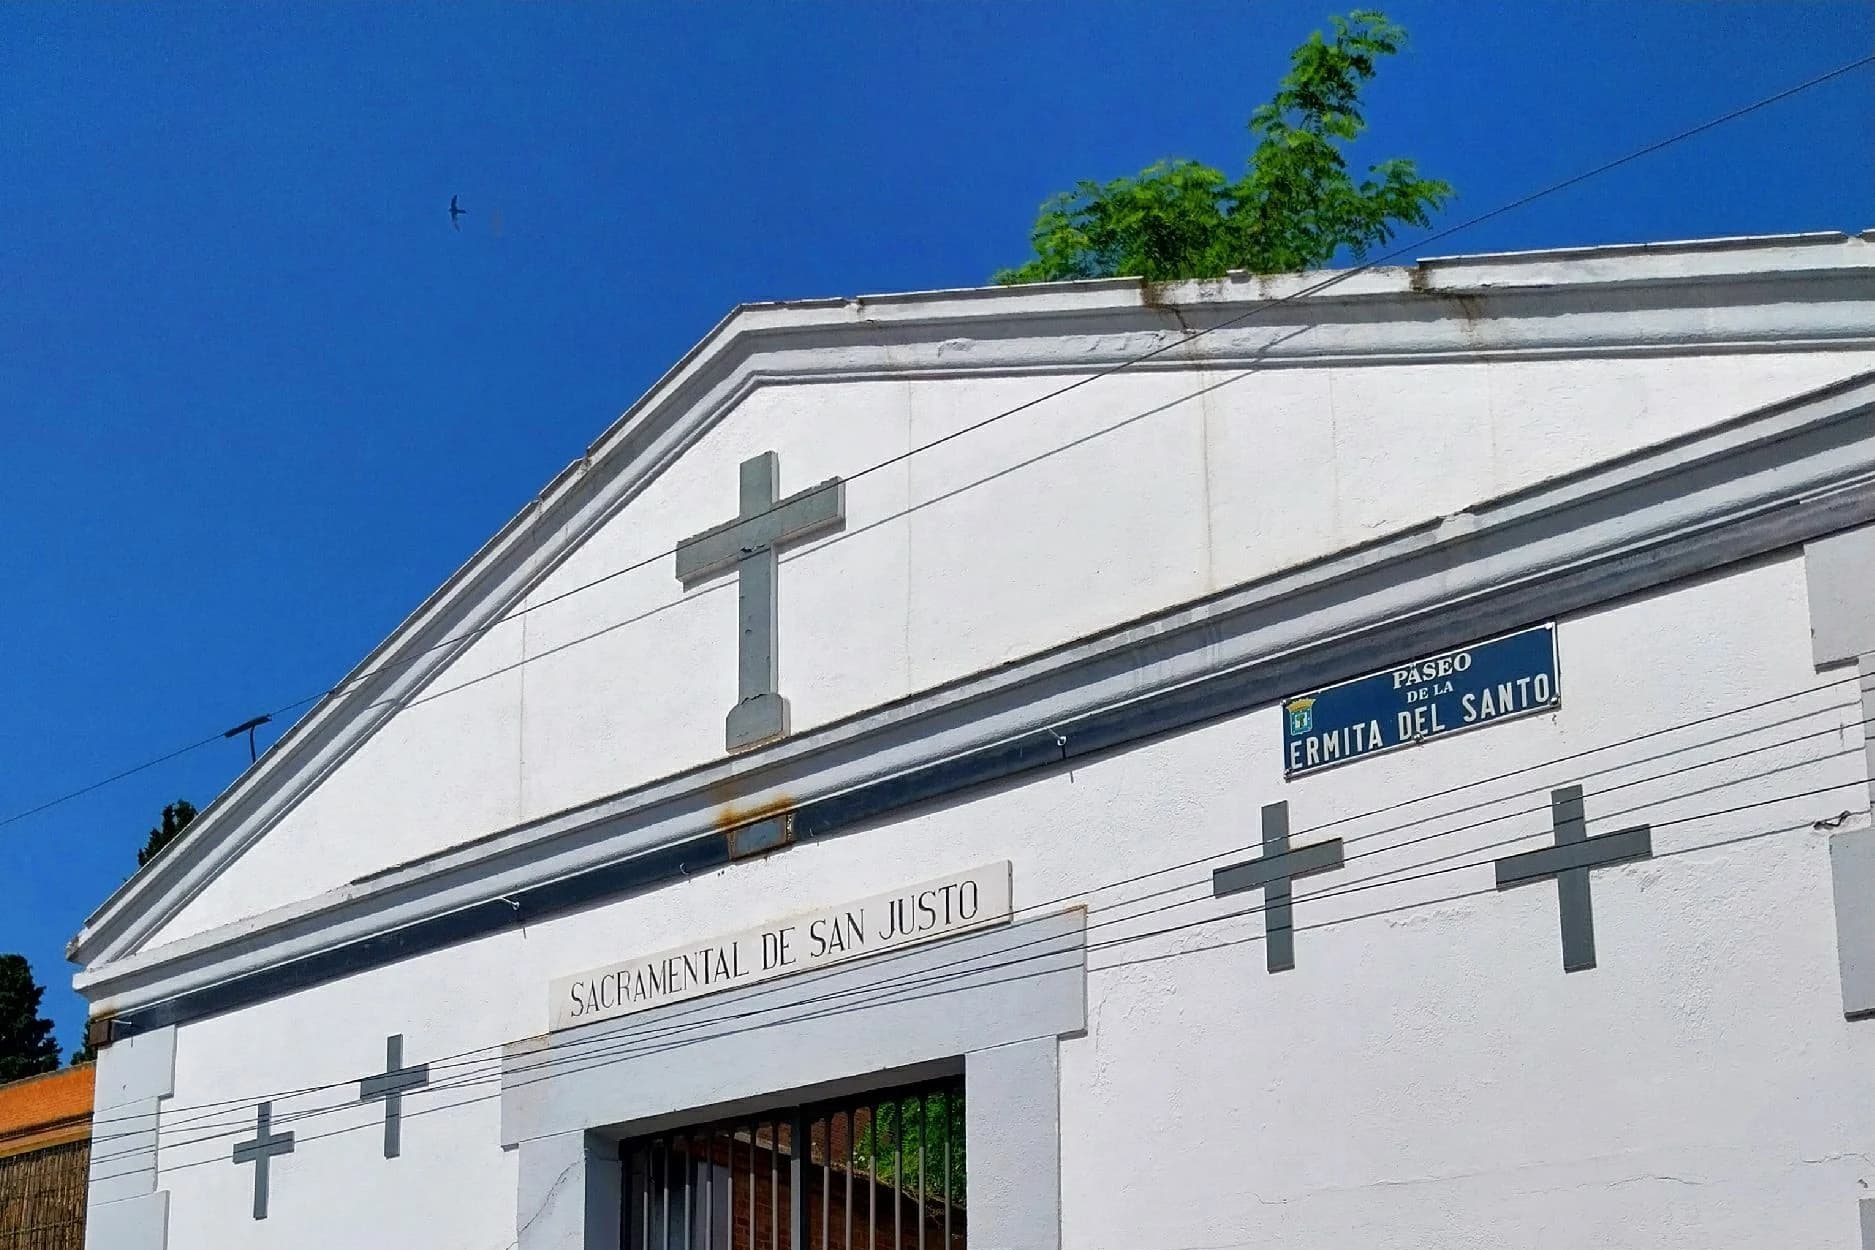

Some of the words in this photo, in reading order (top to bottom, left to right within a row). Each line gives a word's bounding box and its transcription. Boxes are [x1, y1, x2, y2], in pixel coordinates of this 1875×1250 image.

[1393, 652, 1472, 689] PASEO
[1407, 687, 1429, 704] DE
[1433, 680, 1454, 697] LA
[1290, 719, 1384, 769] ERMITA
[1398, 704, 1445, 740] DEL
[1461, 673, 1550, 722] SANTO
[571, 942, 749, 1017] SACRAMENTAL
[762, 927, 796, 971] DE
[810, 908, 866, 959] SAN
[879, 880, 978, 940] JUSTO
